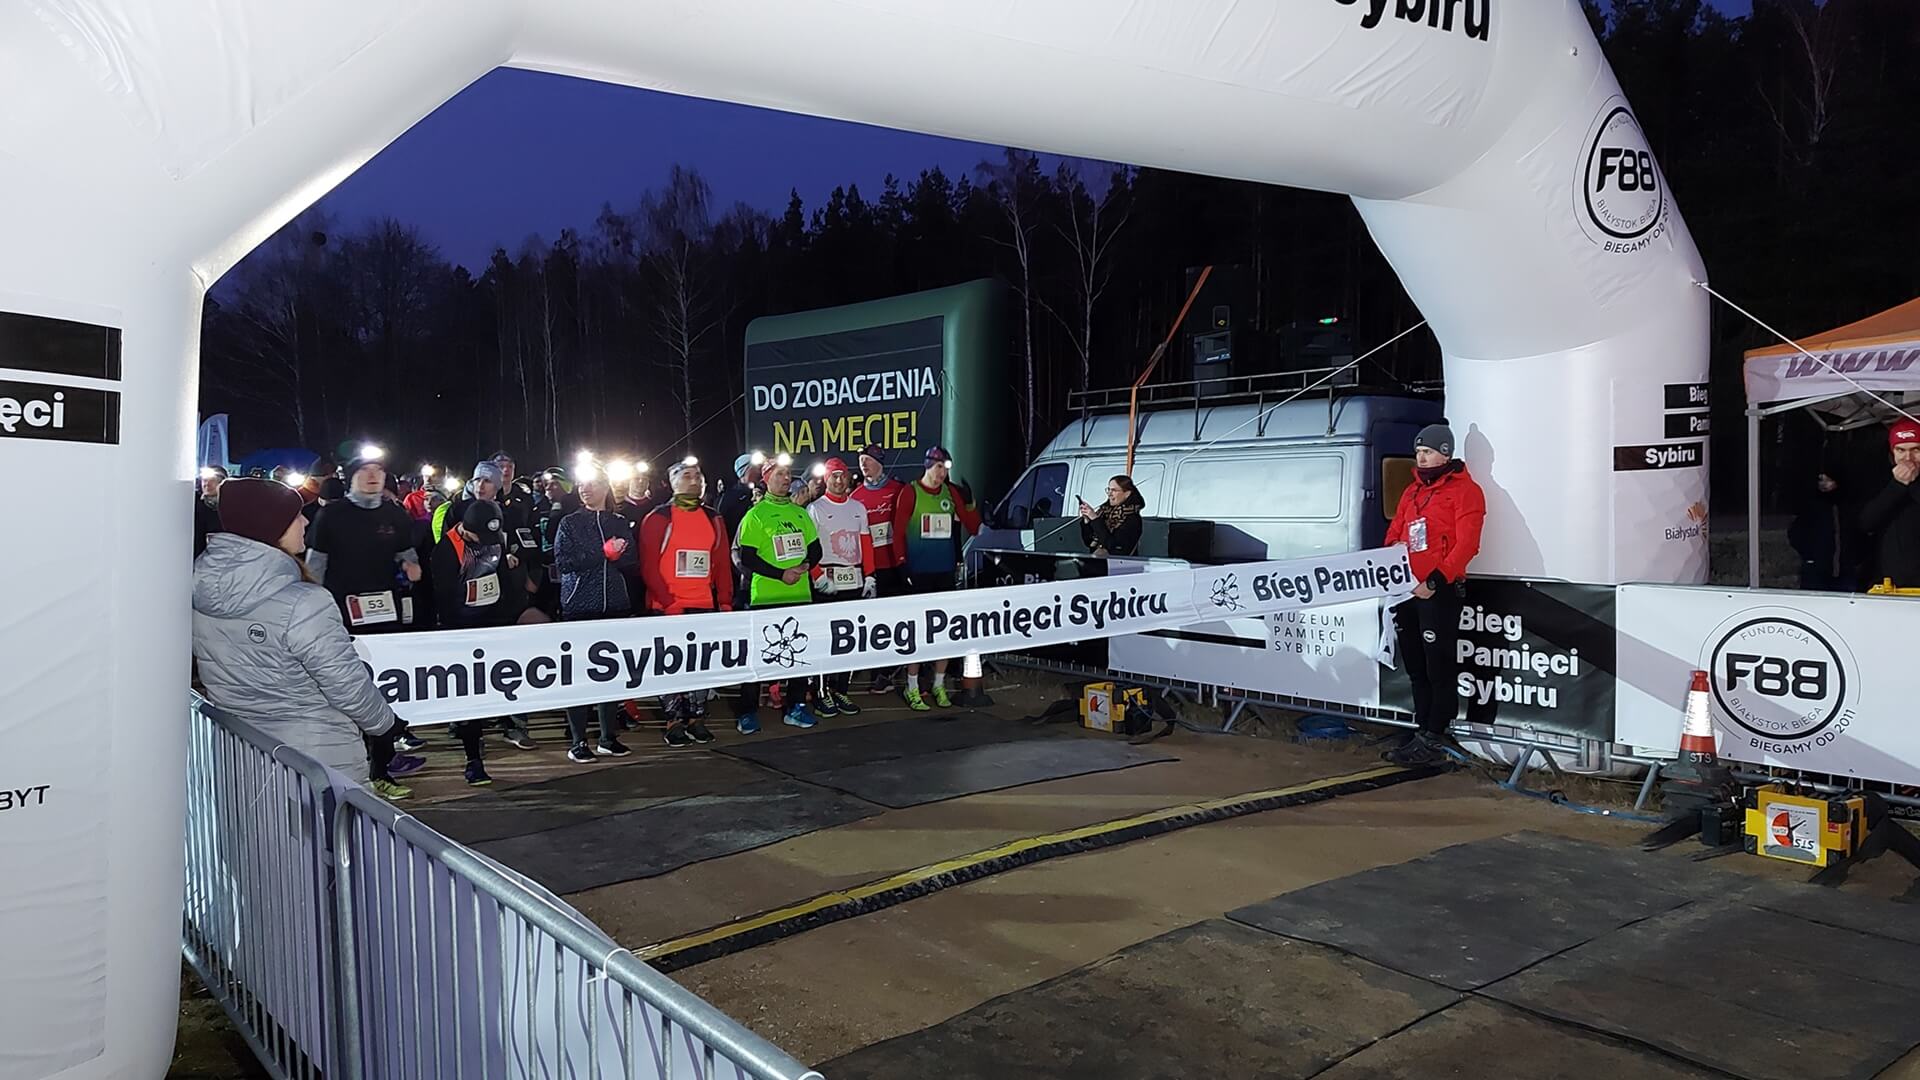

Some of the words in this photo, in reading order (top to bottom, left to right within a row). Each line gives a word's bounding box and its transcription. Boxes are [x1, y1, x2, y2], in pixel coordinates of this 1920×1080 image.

[1596, 147, 1656, 193] F88
[1603, 237, 1652, 254] BIEGAMY
[753, 384, 786, 411] DO
[792, 366, 936, 409] ZOBACZENIA
[773, 420, 815, 454] NA
[822, 411, 918, 453] MECIE!
[1645, 445, 1695, 467] Sybiru
[877, 528, 884, 536] 2
[1665, 525, 1700, 541] Białystok
[786, 538, 801, 548] 146
[482, 581, 494, 593] 33
[837, 573, 854, 582] 663
[1253, 572, 1313, 604] Bieg
[1314, 556, 1411, 594] Pamięci
[368, 599, 384, 609] 53
[830, 614, 916, 656] Bieg
[925, 596, 1062, 645] Pamięci
[1069, 587, 1169, 630] Sybiru
[1273, 612, 1345, 627] MUZEUM
[1458, 605, 1522, 641] Bieg
[1274, 626, 1345, 644] PAMIĘCI
[1740, 625, 1810, 645] FUNDACJA
[1275, 640, 1335, 657] SYBIRU
[1457, 639, 1578, 678] Pamięci
[362, 640, 573, 704] amięci
[587, 631, 749, 689] Sybiru
[1726, 653, 1827, 701] F88
[1457, 672, 1557, 708] Sybiru
[1730, 697, 1789, 731] BIAŁYSTOK
[1792, 706, 1824, 730] BIEGA
[1750, 737, 1813, 754] BIEGAMY
[1815, 731, 1836, 747] OD
[1834, 708, 1857, 734] 2011
[1689, 752, 1712, 764] STS
[1794, 838, 1815, 850] STS
